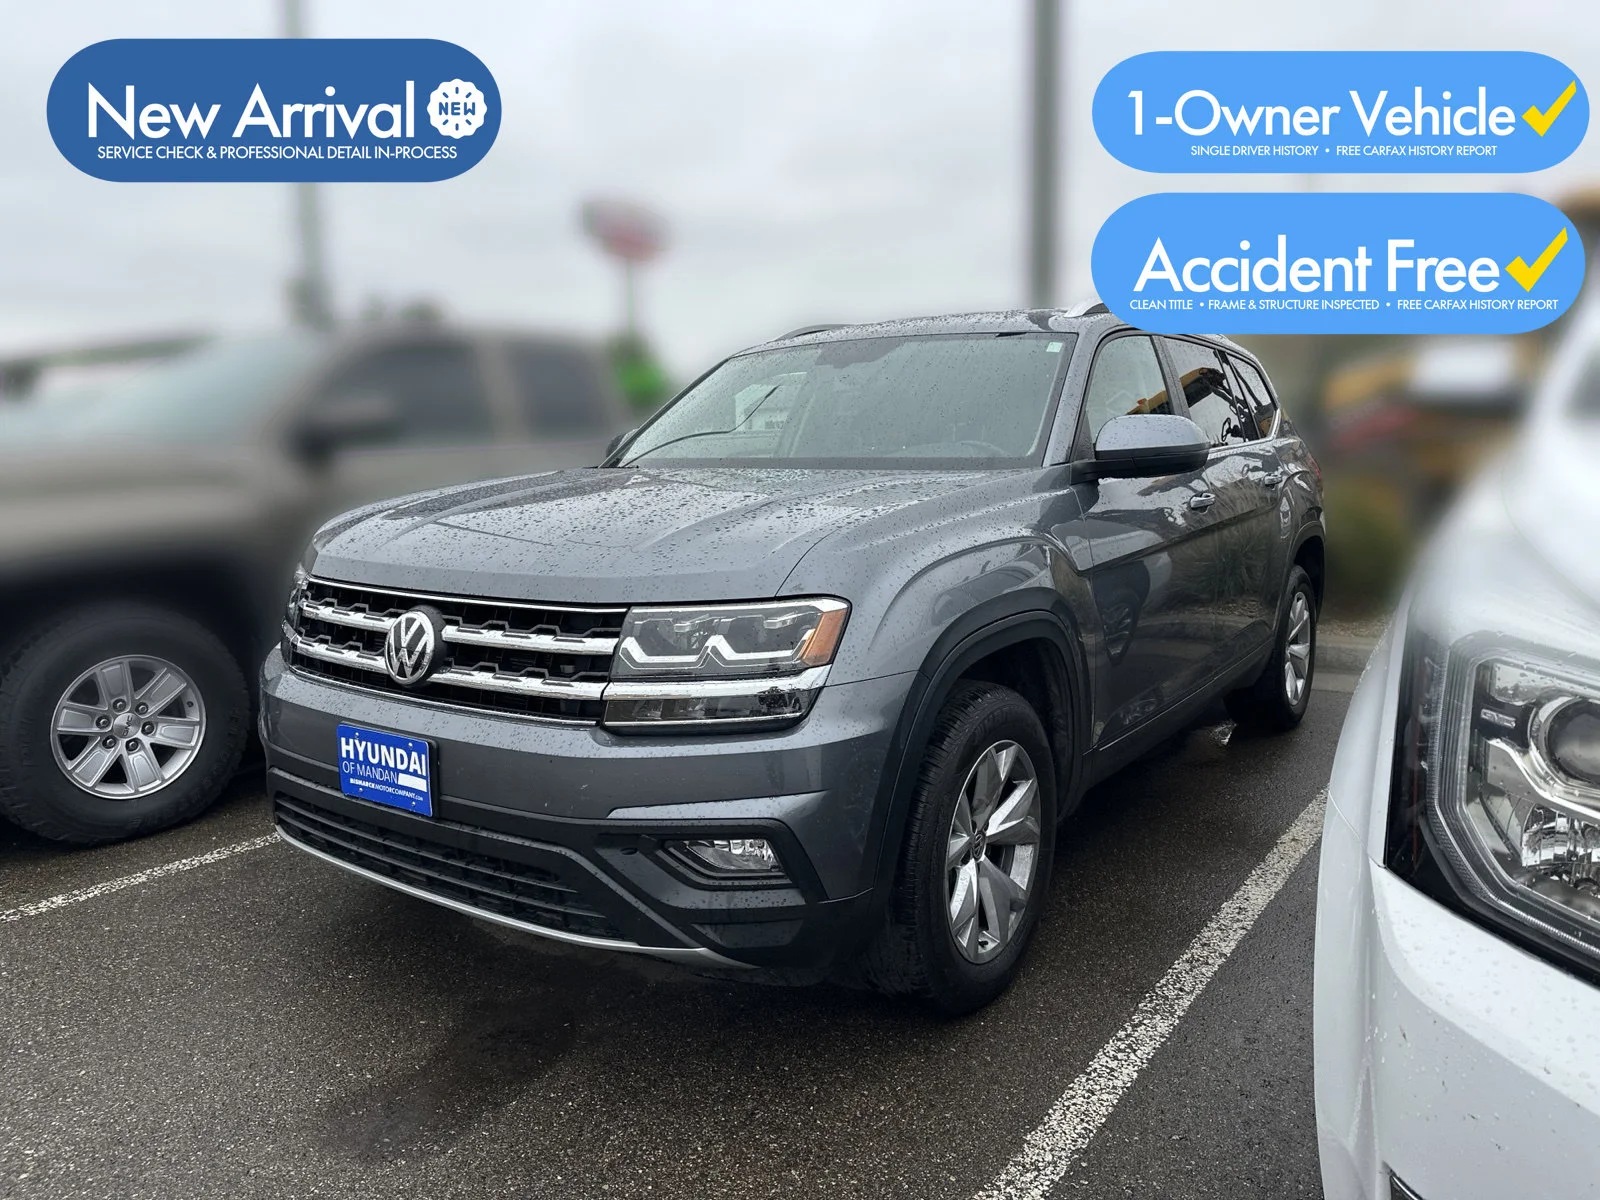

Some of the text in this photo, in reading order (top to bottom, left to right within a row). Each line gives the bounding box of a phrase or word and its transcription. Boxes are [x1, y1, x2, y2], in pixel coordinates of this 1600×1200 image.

[340, 737, 427, 776] HYUNDAI
[342, 761, 398, 784] OF MANDAN
